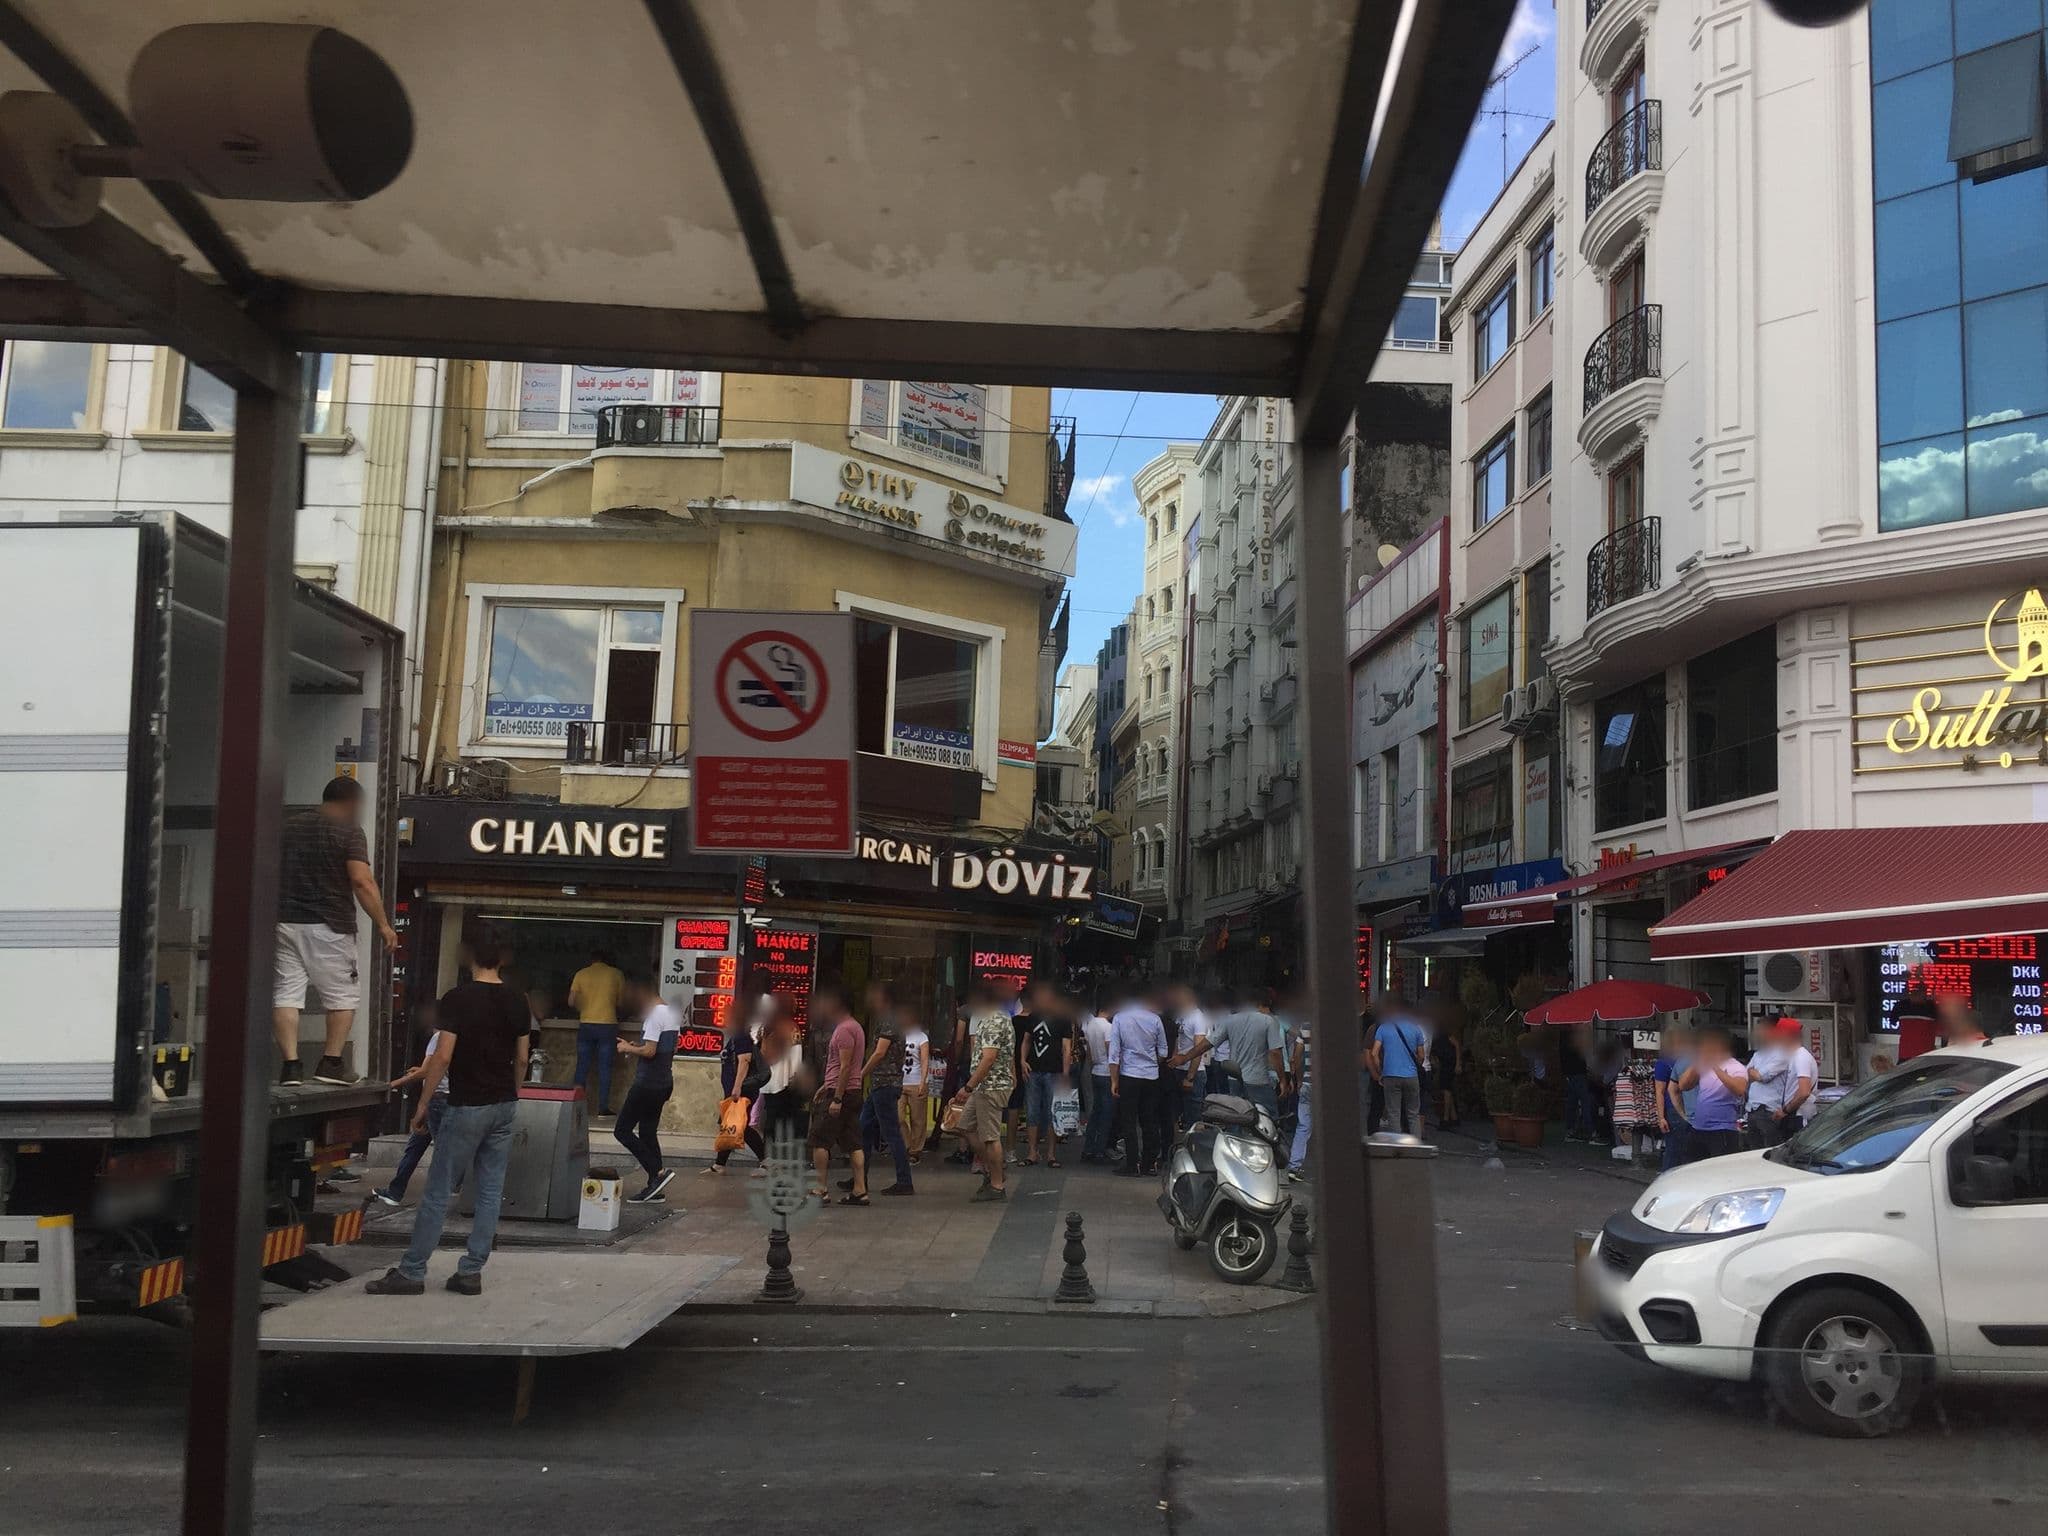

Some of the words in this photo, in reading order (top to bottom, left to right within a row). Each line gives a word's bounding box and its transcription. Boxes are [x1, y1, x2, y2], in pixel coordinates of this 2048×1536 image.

[1264, 398, 1277, 450] TEL
[868, 468, 917, 501] THY
[837, 491, 922, 529] PEGASUS
[1261, 459, 1274, 581] GLORIOUS
[1886, 686, 2048, 753] Sulta
[496, 720, 544, 735] Tel:+90555
[545, 721, 562, 736] 088
[900, 742, 937, 761] Tel:+90555
[938, 748, 951, 764] 088
[952, 751, 961, 765] 92
[962, 752, 971, 767] 00
[470, 818, 667, 859] CHANGE
[951, 849, 1093, 901] DÖVİZ
[1469, 883, 1498, 902] BOSNA
[1501, 880, 1518, 897] PUB
[677, 920, 729, 935] CHANGE
[680, 936, 725, 950] OFFICE
[770, 952, 785, 962] NO
[975, 951, 1032, 970] EXCHANGE
[1913, 948, 1936, 958] SELL
[673, 959, 684, 974] $
[1809, 951, 1820, 993] VESTEL
[1880, 963, 1907, 976] GBP
[2012, 966, 2041, 979] DKK
[665, 975, 692, 985] DOLAR
[1882, 981, 1906, 994] CHF
[2012, 985, 2041, 997] AUD
[2014, 1005, 2042, 1017] CAD
[2015, 1023, 2043, 1035] SAR
[1810, 1026, 1822, 1067] ESTEL
